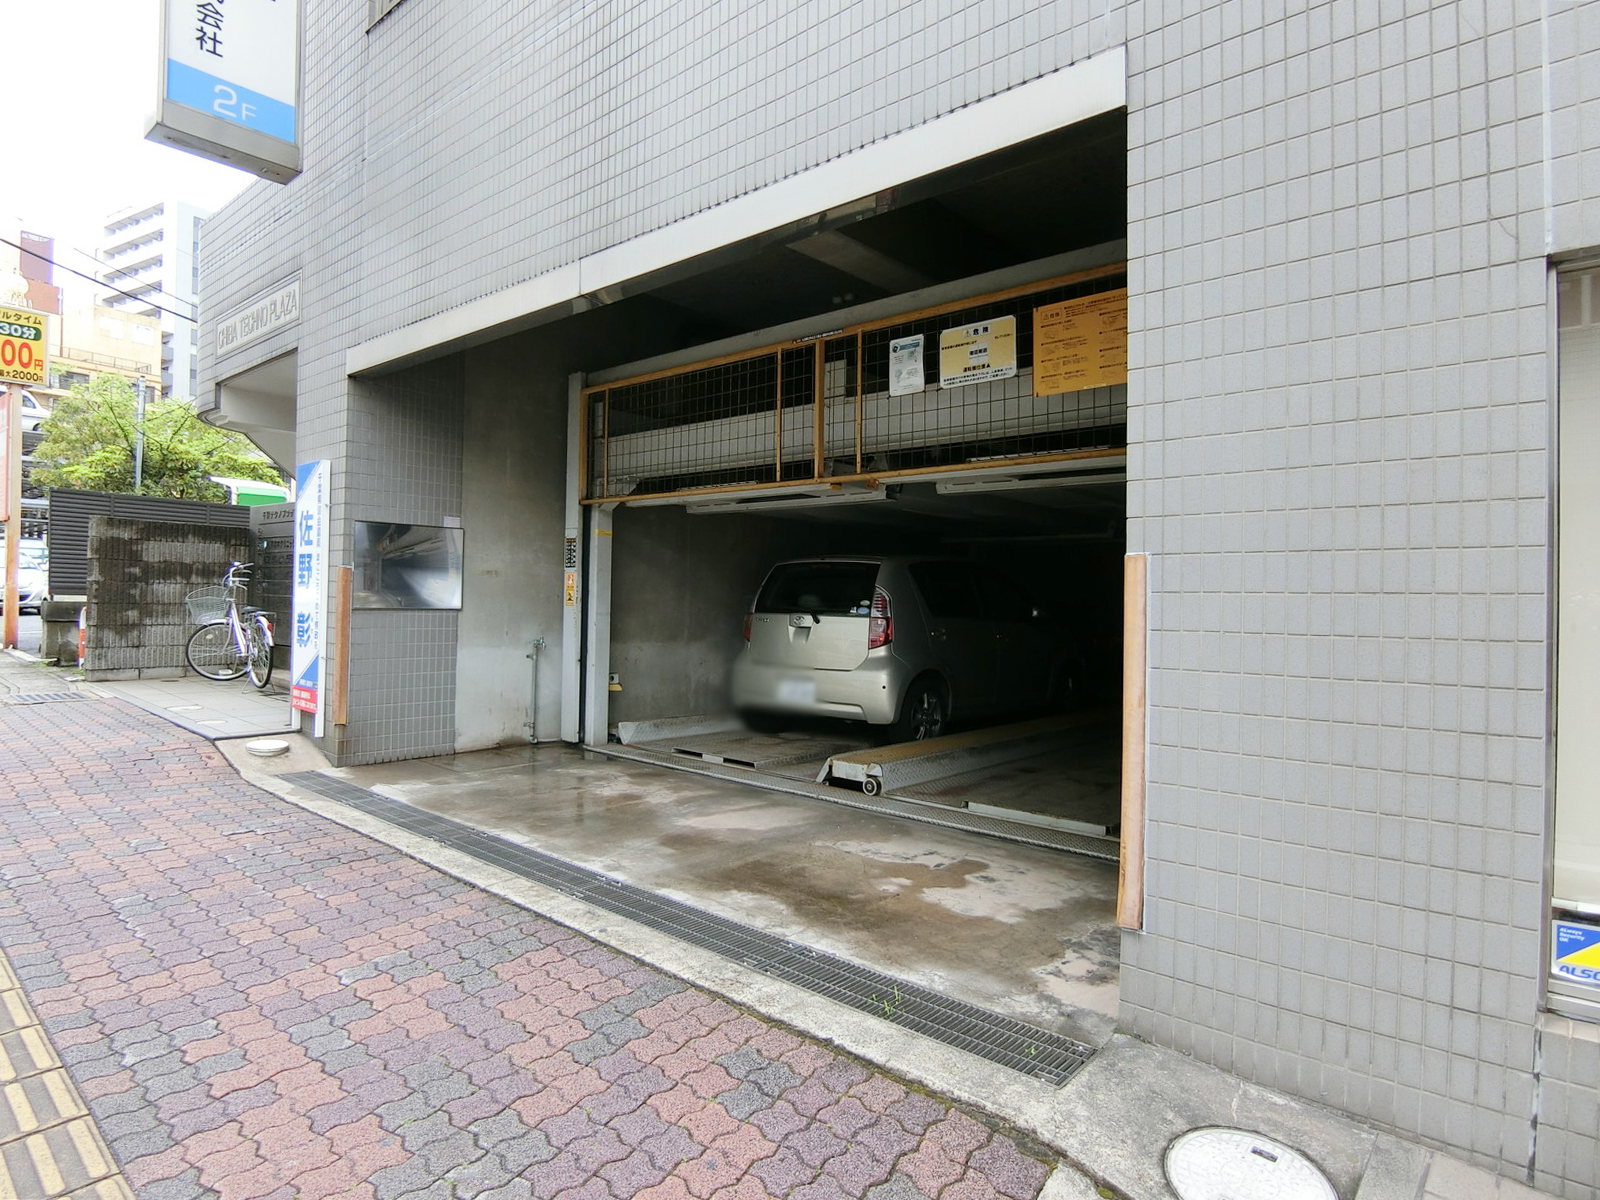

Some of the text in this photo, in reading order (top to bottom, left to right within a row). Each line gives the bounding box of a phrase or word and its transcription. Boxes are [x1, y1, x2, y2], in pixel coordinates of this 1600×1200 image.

[195, 0, 225, 58] 会社
[212, 84, 257, 121] 2F
[218, 289, 297, 350] CHIBA TECHNO PLAZA
